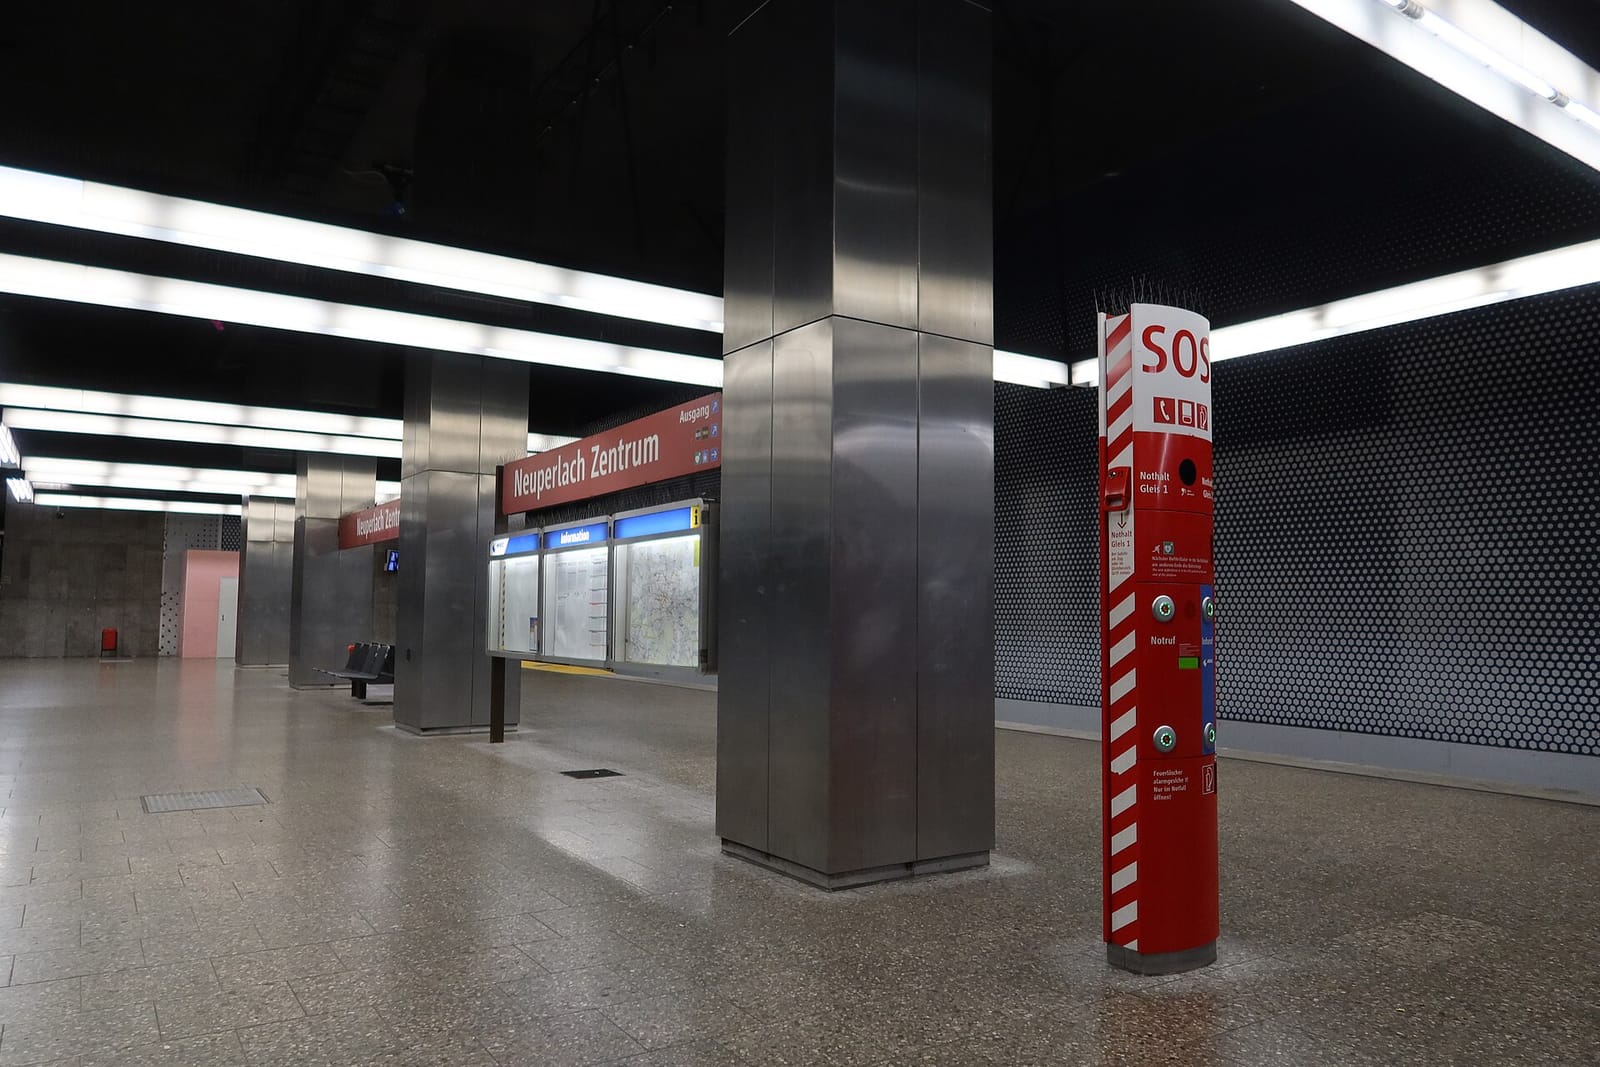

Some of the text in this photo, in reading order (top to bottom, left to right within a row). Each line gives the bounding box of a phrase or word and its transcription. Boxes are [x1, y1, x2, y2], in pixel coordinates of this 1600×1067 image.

[1141, 324, 1210, 384] SOS
[679, 405, 710, 423] Ausgang
[514, 433, 659, 500] Neuperlach Zentrum
[1140, 471, 1170, 481] Nothalt
[1140, 484, 1169, 494] Gleis 1
[356, 508, 384, 540] Neuperlach
[561, 529, 590, 545] Information
[1111, 530, 1133, 538] Nothalt
[1111, 540, 1126, 548] Gleis
[1150, 635, 1176, 645] Notruf
